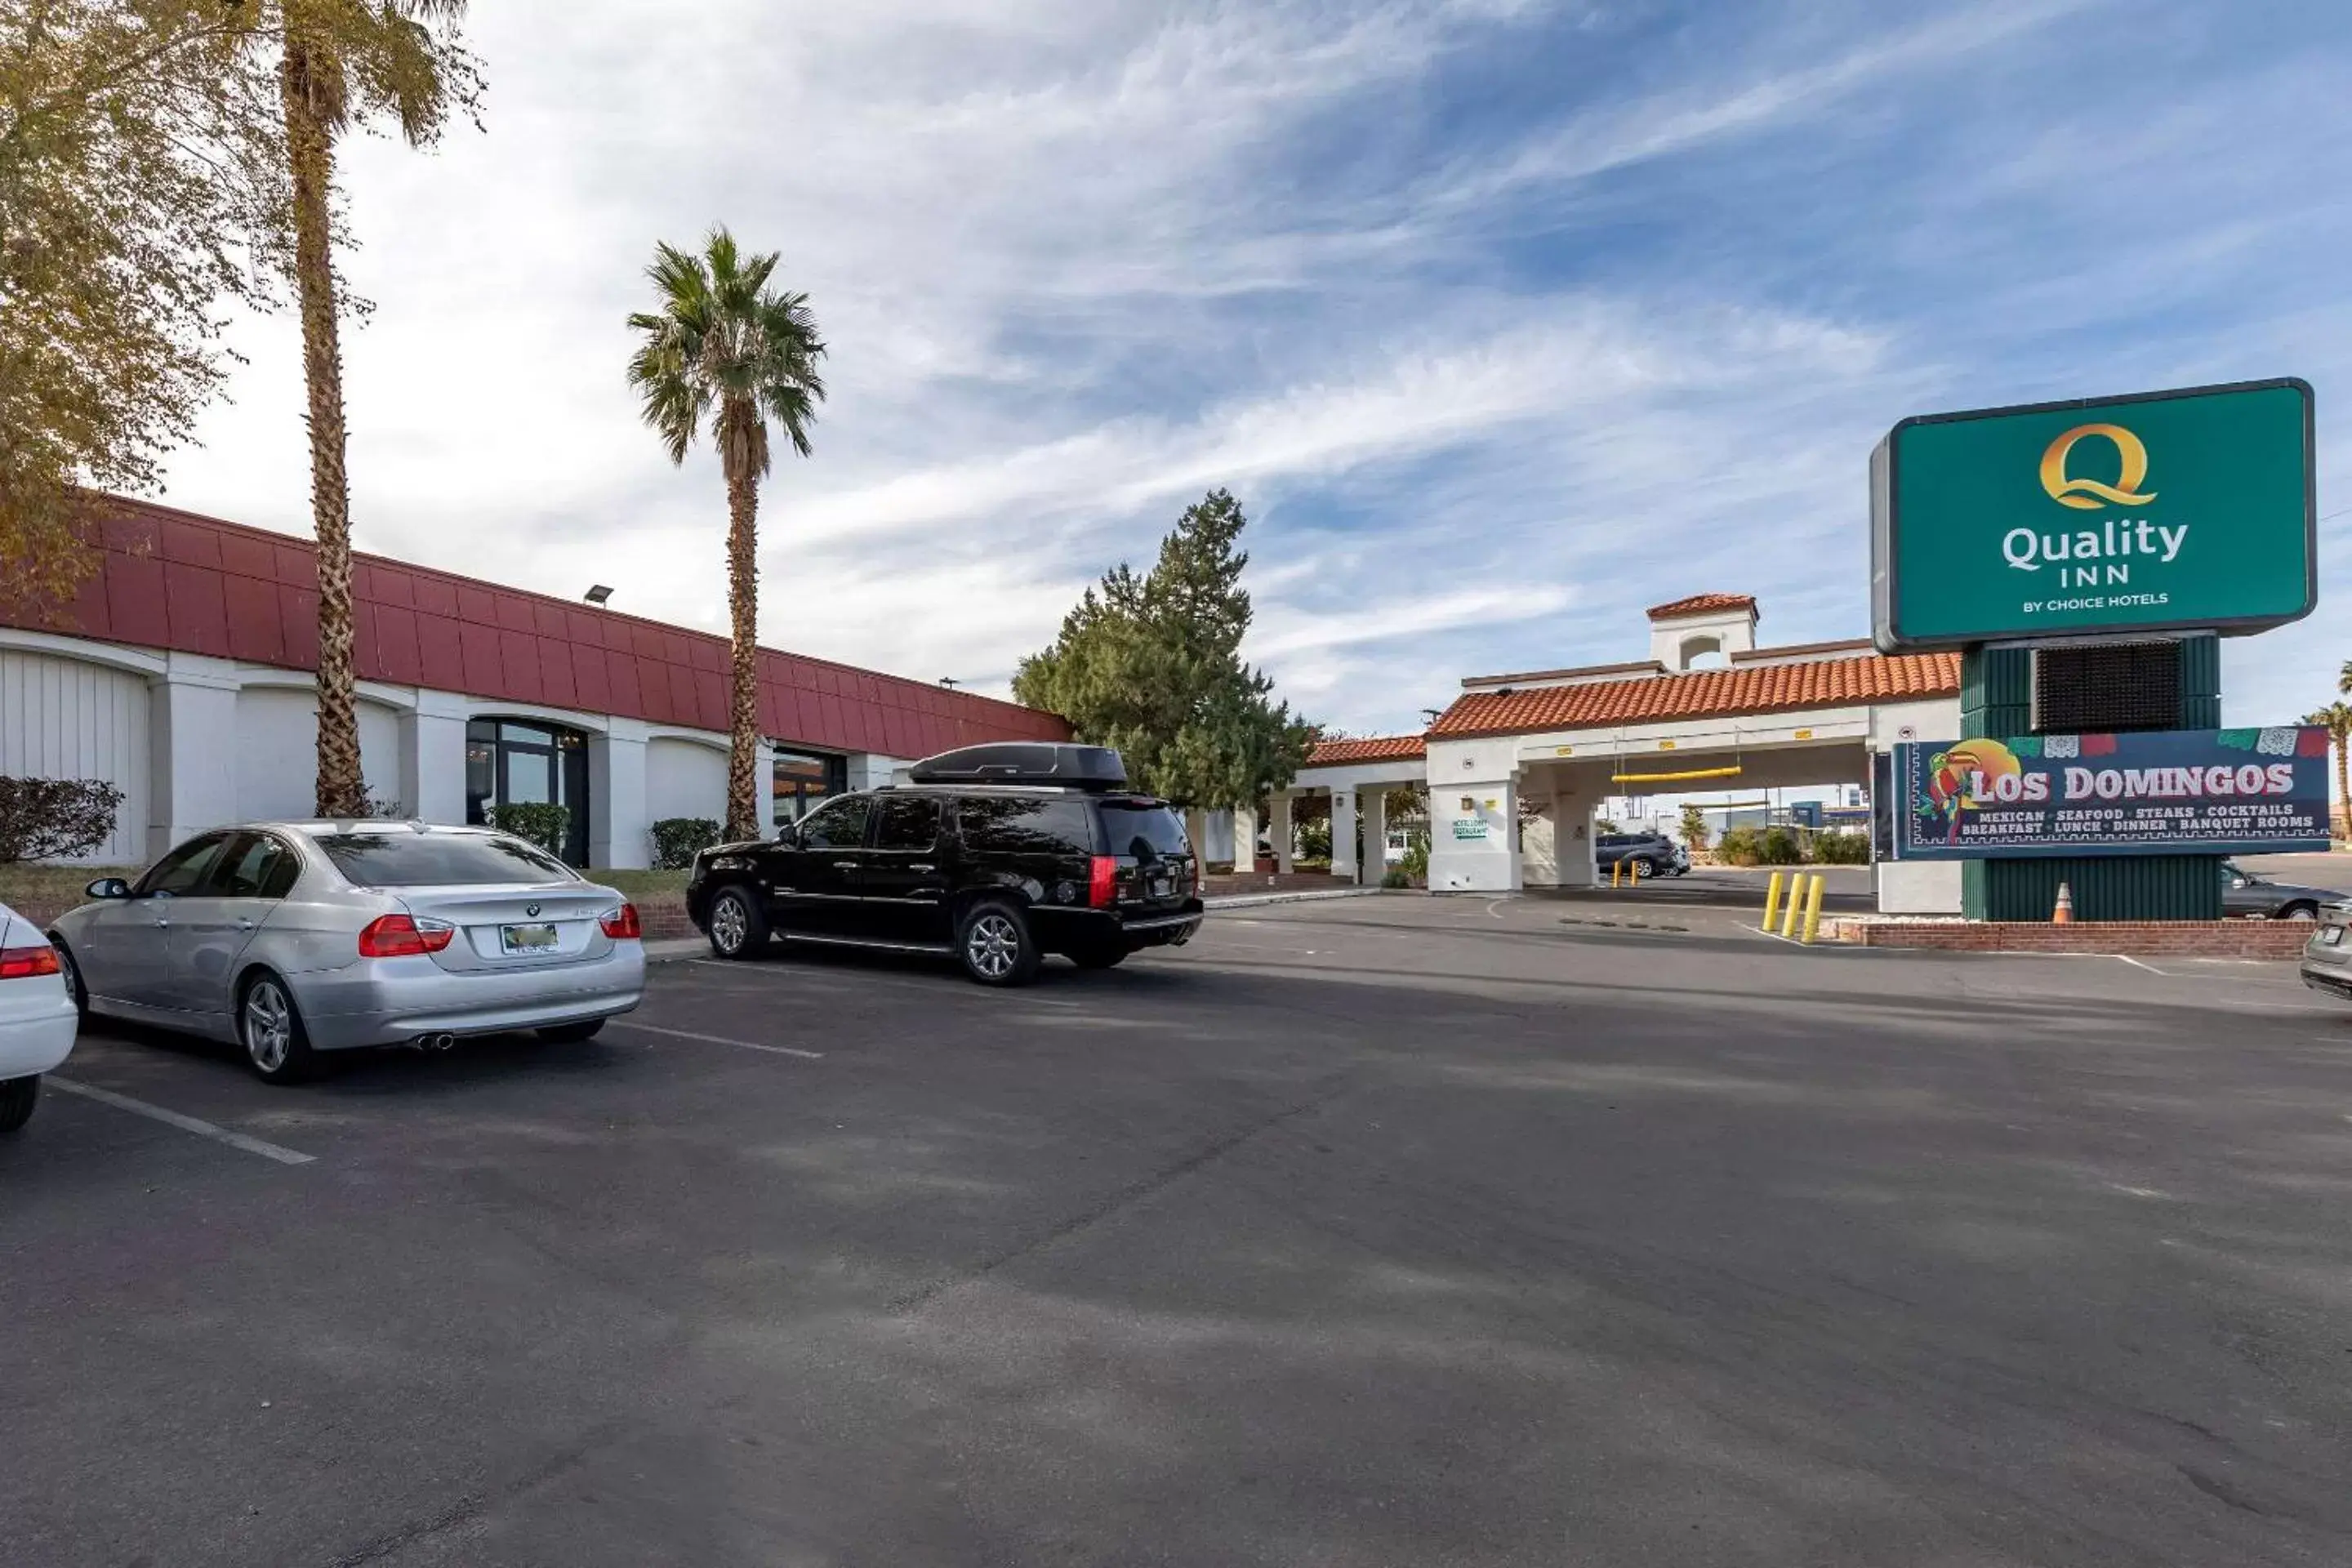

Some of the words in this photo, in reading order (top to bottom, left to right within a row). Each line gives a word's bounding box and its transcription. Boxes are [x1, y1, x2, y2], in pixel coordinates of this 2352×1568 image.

[2041, 423, 2158, 509] Q
[2002, 519, 2188, 571] Quality
[2060, 564, 2129, 589] INN
[2023, 599, 2042, 612] BY
[2047, 597, 2104, 611] CHOICE
[2109, 593, 2169, 608] HOTELS
[1971, 770, 2049, 802] LOS
[2064, 763, 2294, 800] DOMINGOS
[1962, 822, 2042, 835] BREAKFAST
[2055, 821, 2102, 832] LUNCH
[2113, 820, 2167, 831] DINNER
[2180, 818, 2251, 830] BANQUET
[2257, 816, 2313, 827] ROOMS
[1979, 811, 2045, 822] MEXICAN
[2056, 808, 2123, 821] SEAFOOD
[2136, 807, 2194, 819] STEAKS
[2207, 804, 2293, 817] COCKTAILS
